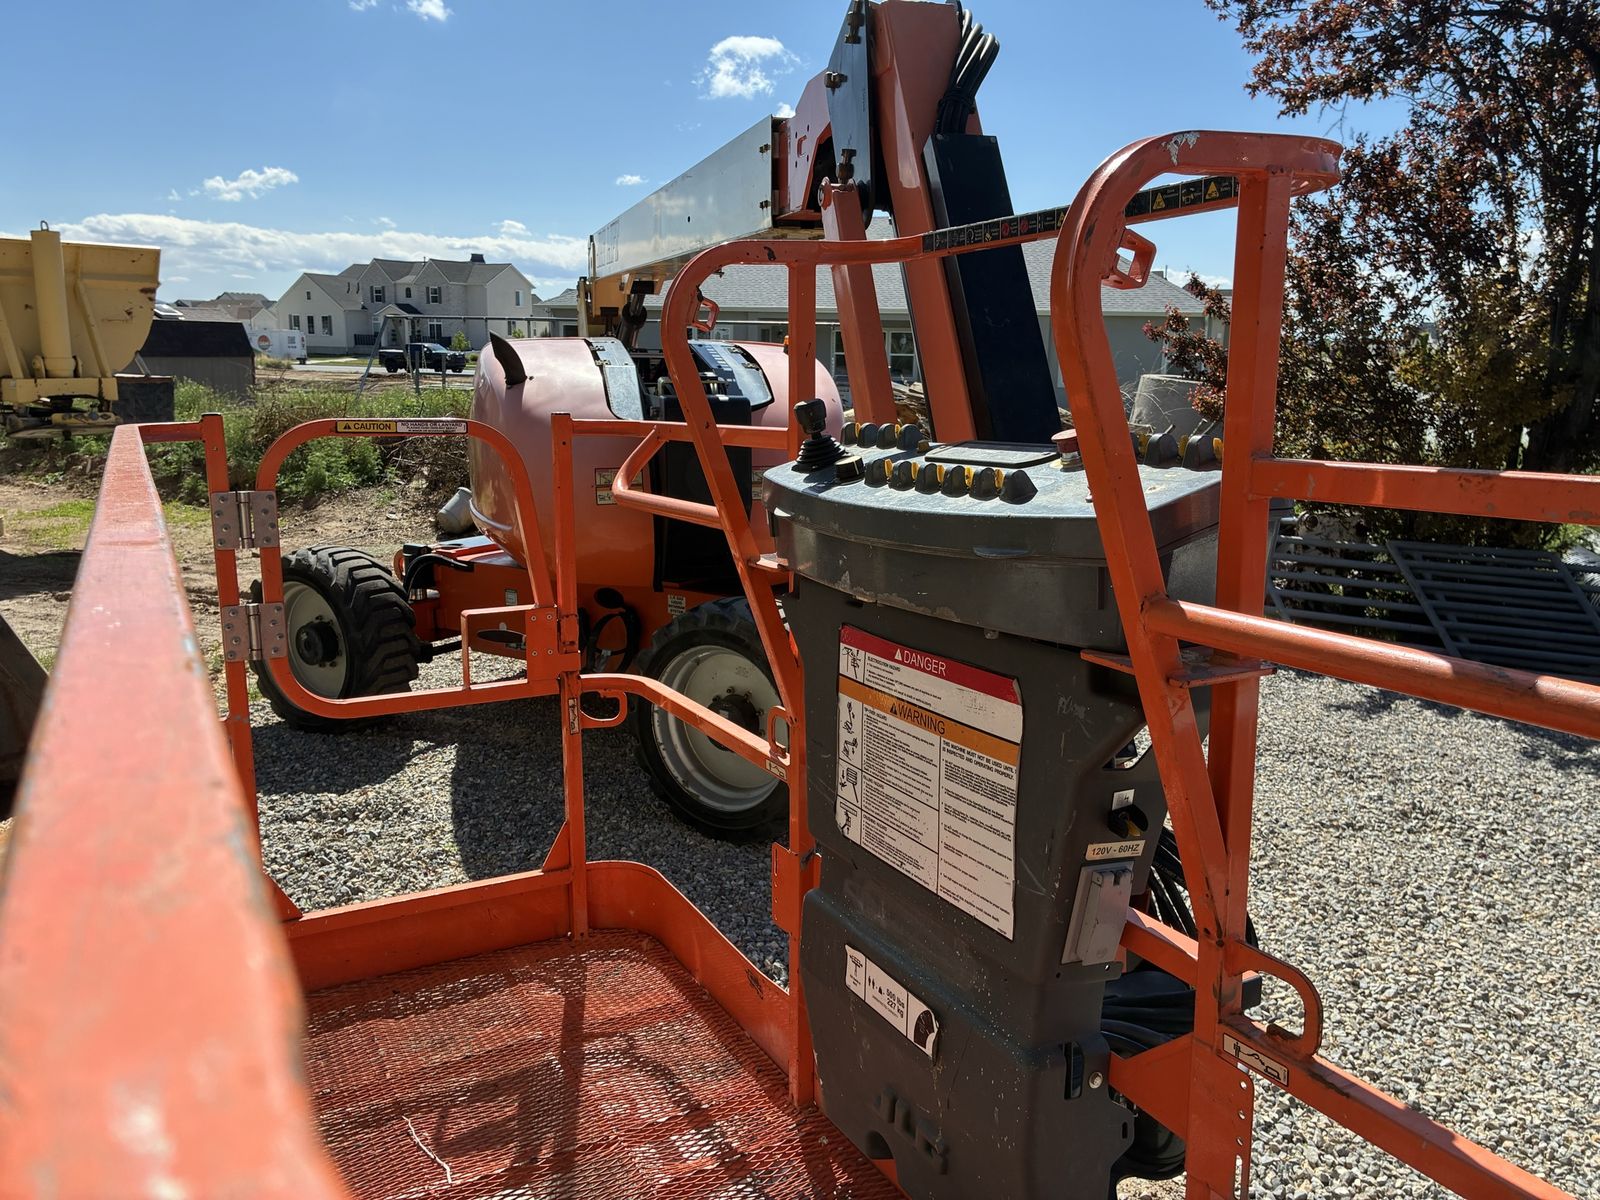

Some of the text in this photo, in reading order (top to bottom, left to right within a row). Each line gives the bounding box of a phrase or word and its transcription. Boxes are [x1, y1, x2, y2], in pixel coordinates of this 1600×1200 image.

[353, 422, 391, 431] CAUTION
[903, 650, 946, 676] DANGER
[898, 703, 946, 735] WARNING
[1092, 846, 1112, 856] 120V
[1118, 843, 1140, 853] 60HZ
[886, 997, 896, 1010] 227
[897, 1005, 904, 1019] kg
